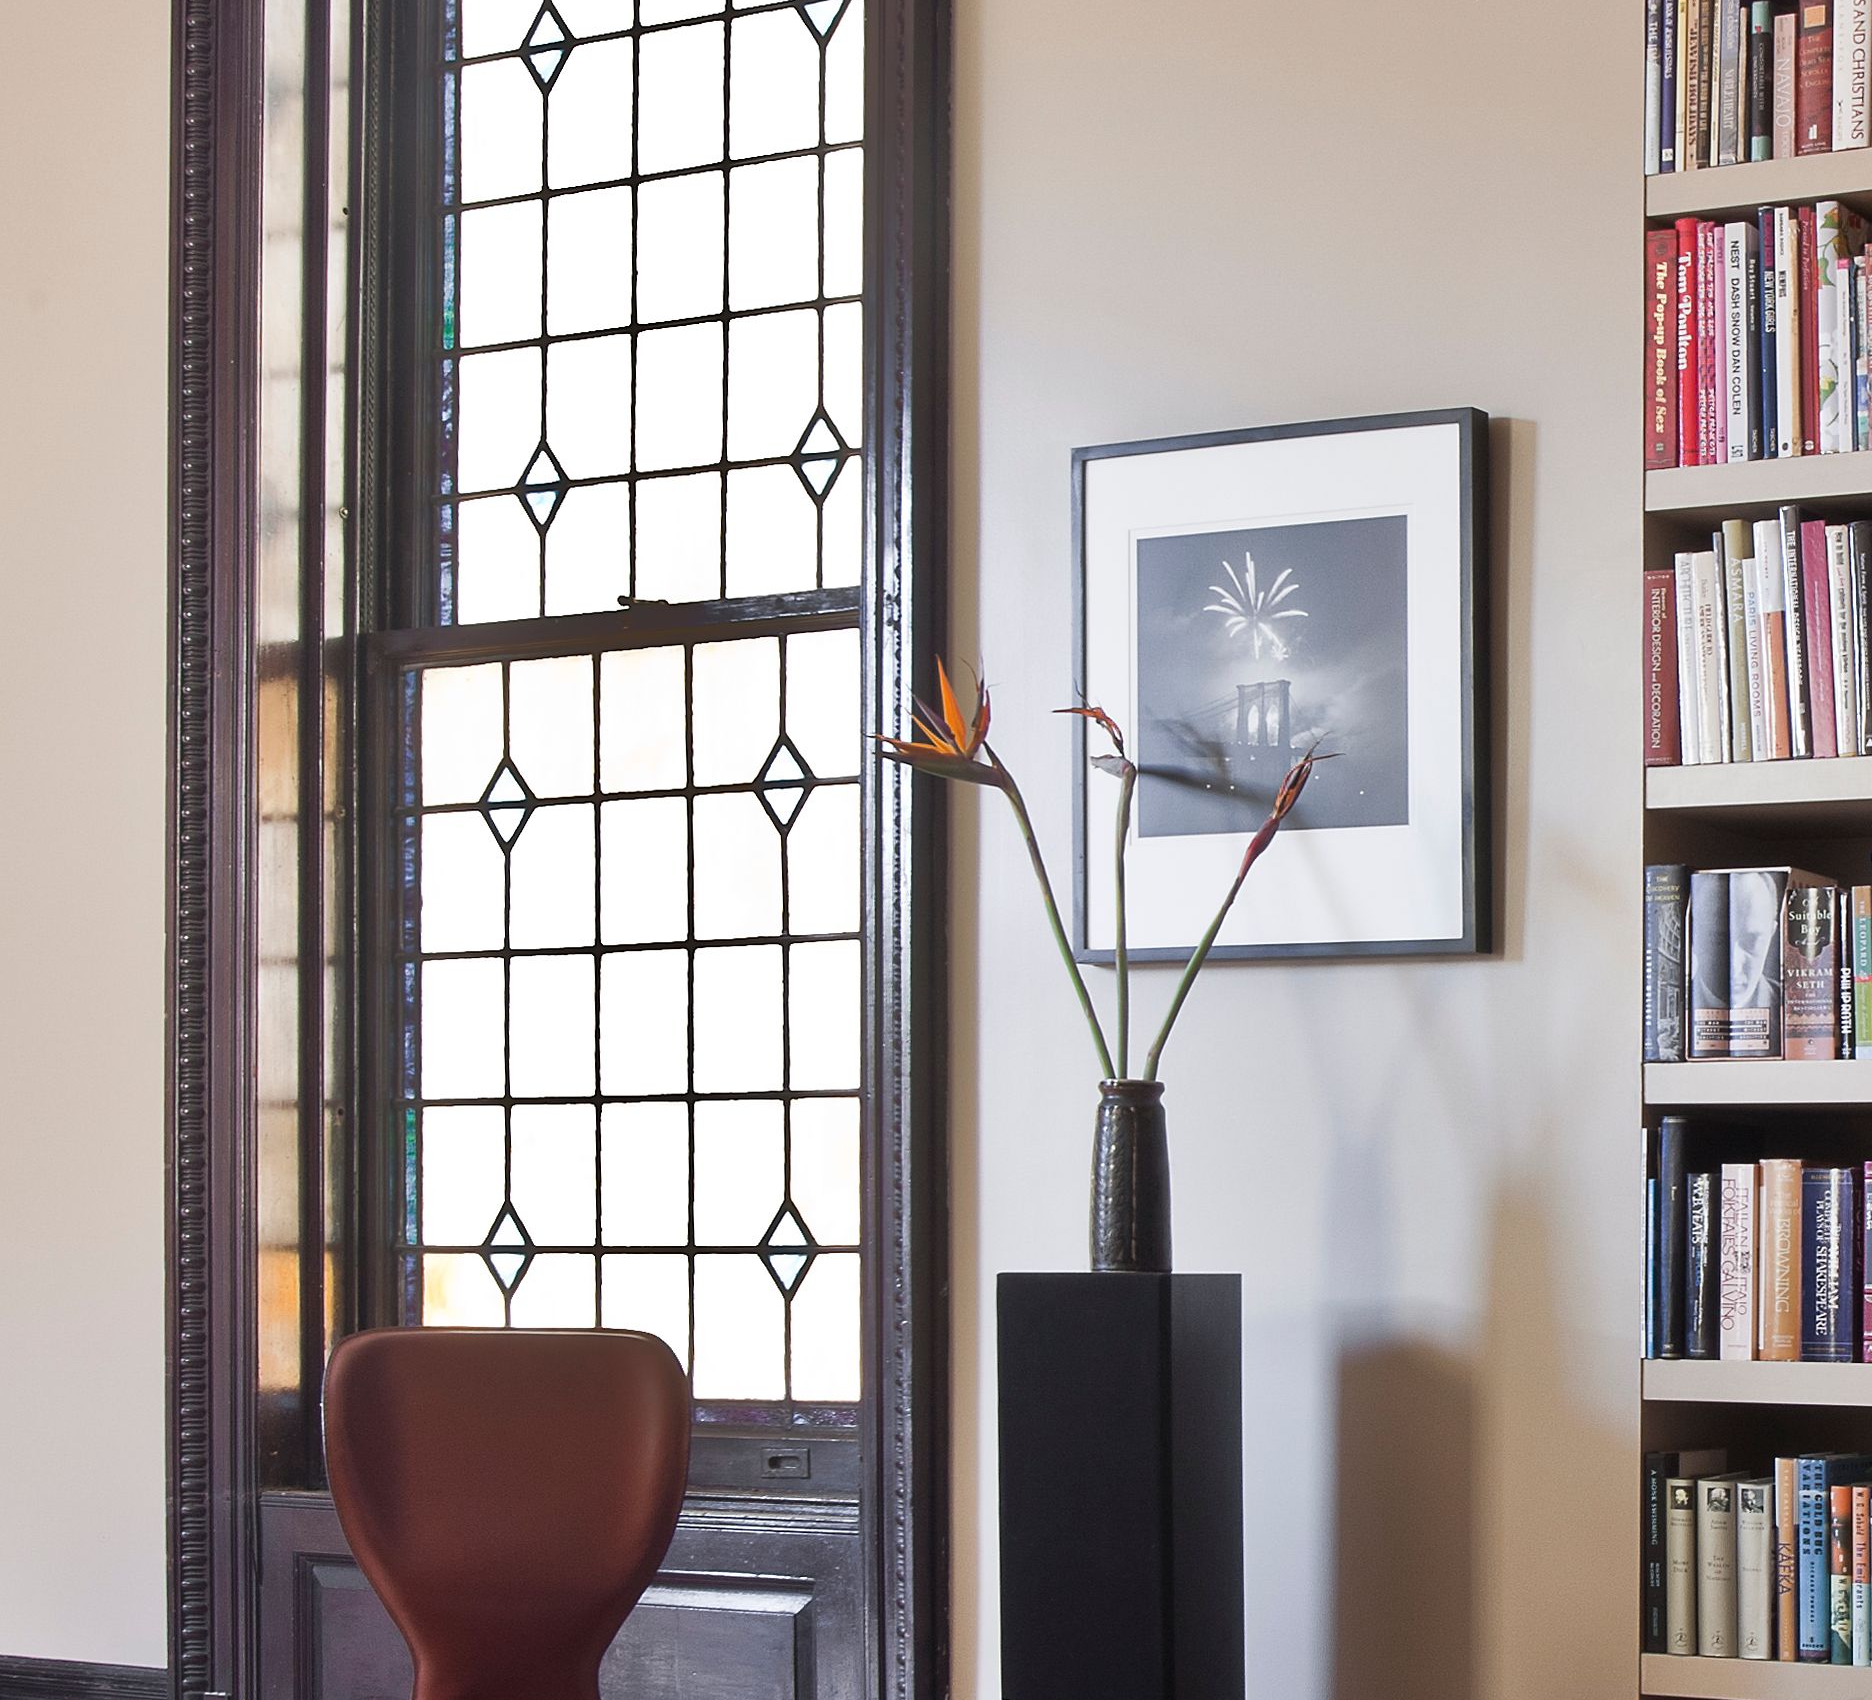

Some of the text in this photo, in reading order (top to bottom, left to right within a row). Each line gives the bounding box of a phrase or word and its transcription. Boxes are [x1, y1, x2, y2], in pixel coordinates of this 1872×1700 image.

[1852, 10, 1863, 44] AND
[1849, 48, 1864, 139] CHRISTIANS
[1730, 241, 1740, 415] NEST DASH SNOW DAN COLEN
[1775, 1218, 1790, 1312] BROWNING
[1815, 1246, 1826, 1335] SHAKESPEARE
